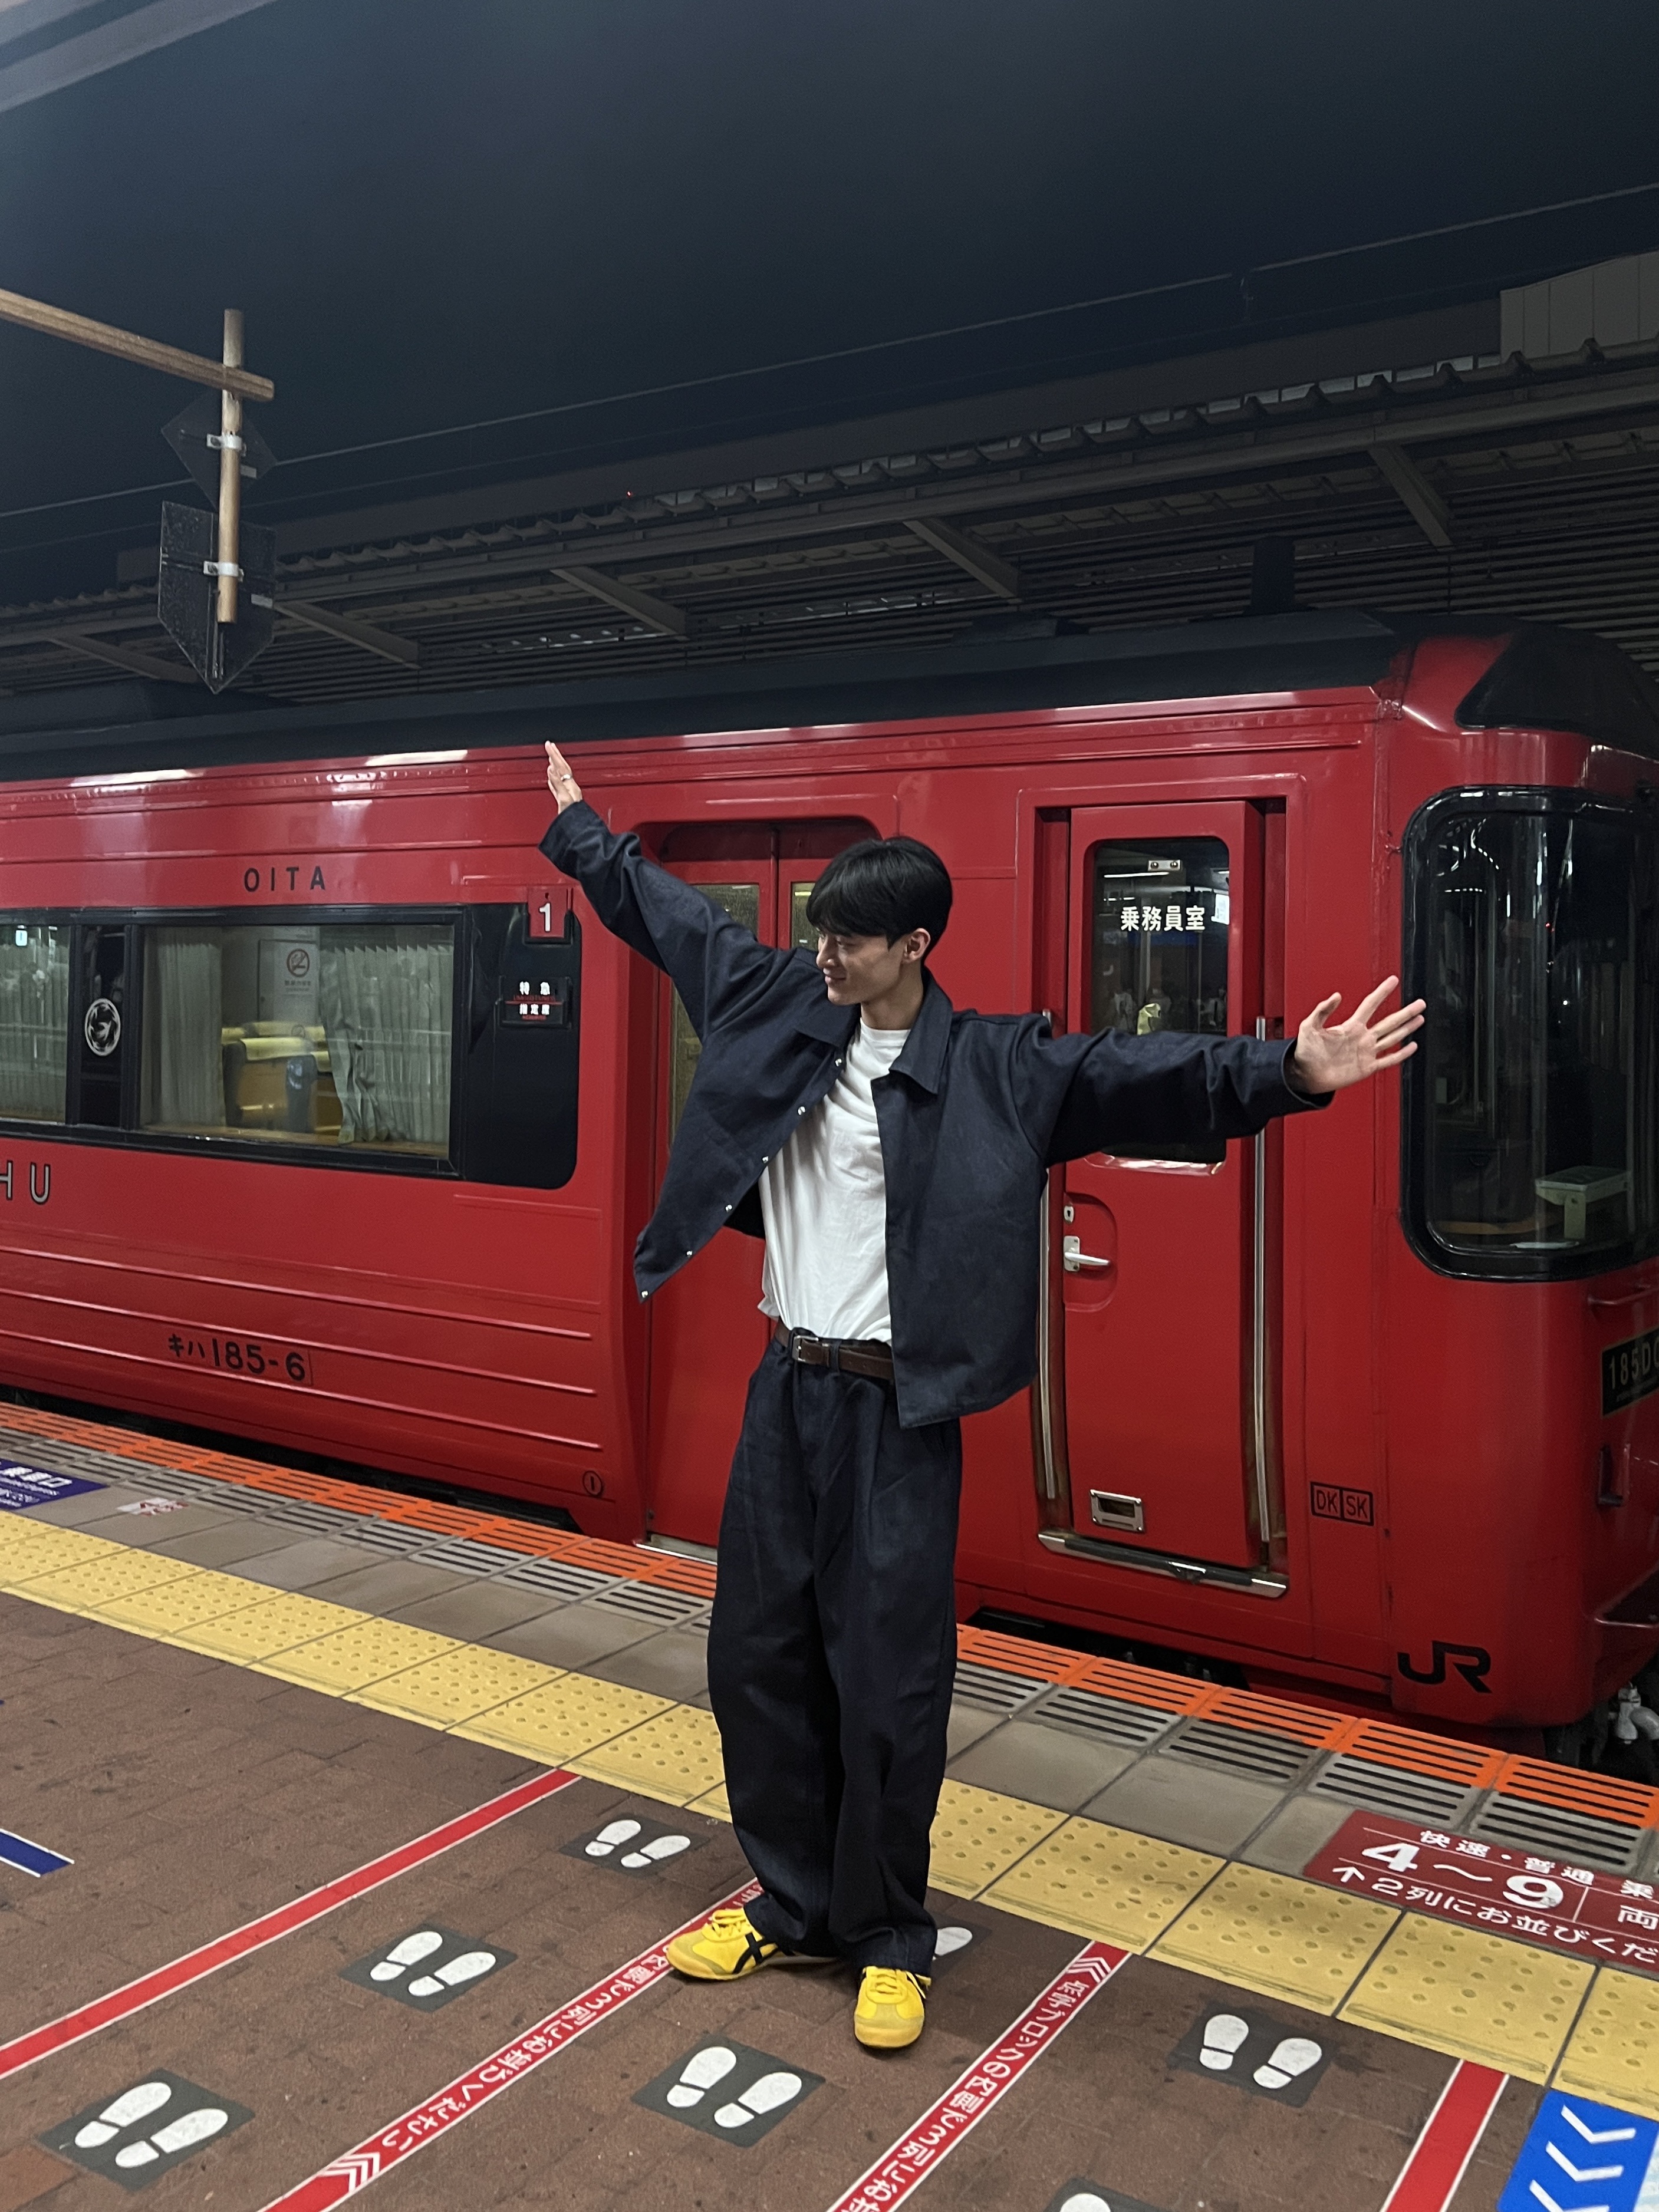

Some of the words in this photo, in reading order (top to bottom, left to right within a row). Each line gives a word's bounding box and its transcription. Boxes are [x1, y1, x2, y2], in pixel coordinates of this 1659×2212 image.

[244, 866, 325, 892] OITA
[539, 902, 551, 932] 1
[1120, 905, 1206, 932] 乗務員室
[1316, 1489, 1338, 1514] DK
[1346, 1495, 1368, 1519] SK
[1397, 1640, 1492, 1694] JR
[1420, 1830, 1595, 1886] 快速・普通
[1620, 1879, 1655, 1900] 乗
[1371, 1877, 1659, 1964] 2列にお並びくだ
[381, 1944, 669, 2151] 内側で3列にお並びください
